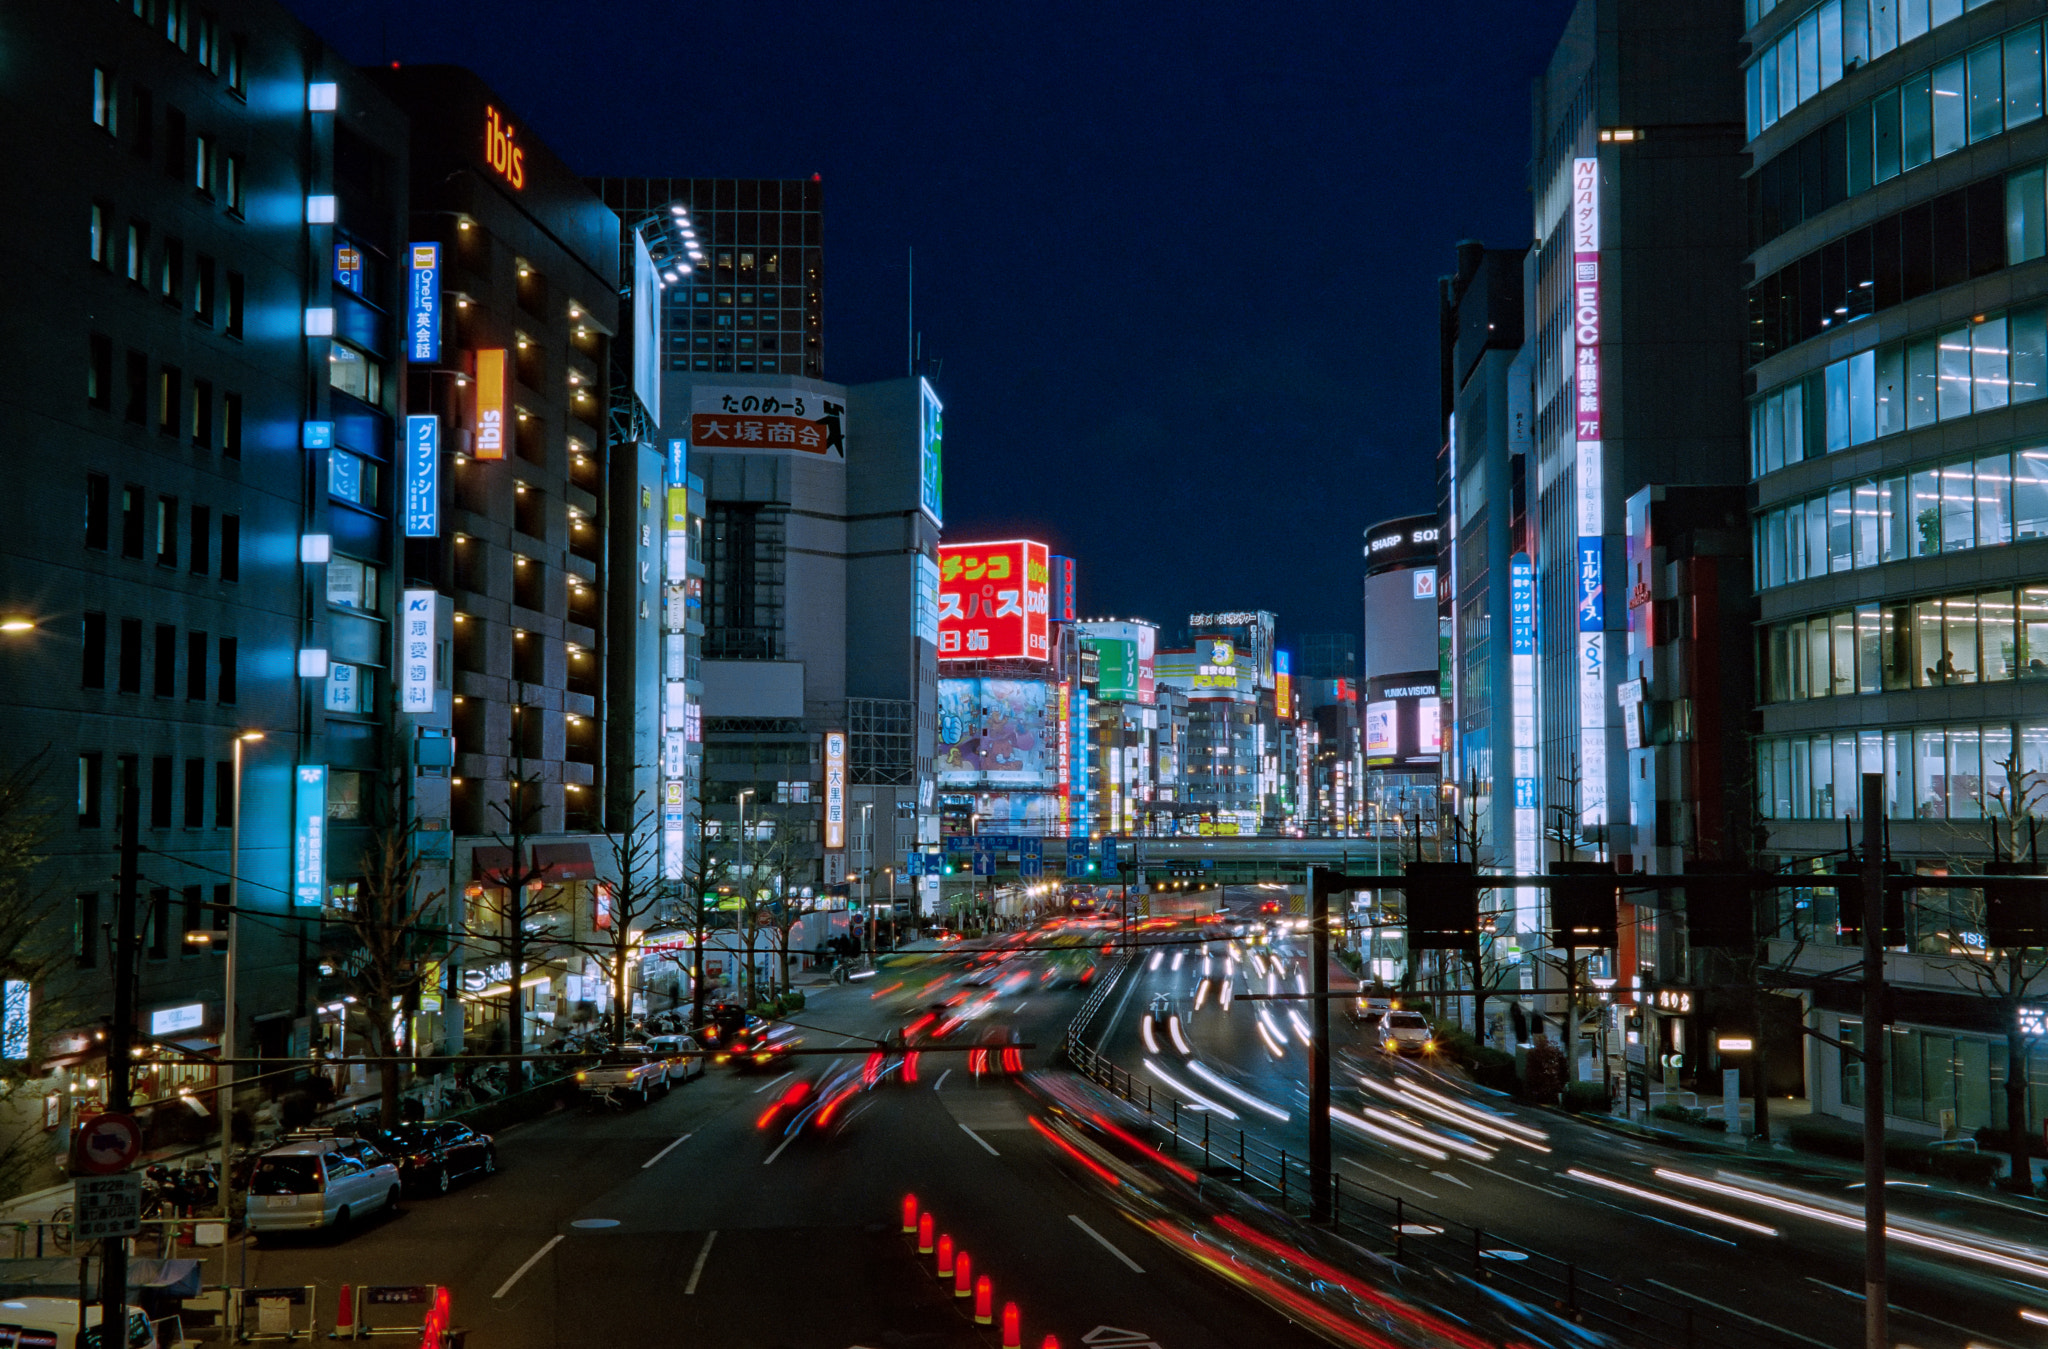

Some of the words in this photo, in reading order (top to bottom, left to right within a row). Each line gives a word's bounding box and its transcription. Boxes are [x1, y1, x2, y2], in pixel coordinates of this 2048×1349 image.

[486, 104, 524, 190] ibis
[722, 394, 805, 416] たのめーる
[478, 410, 501, 450] ibis
[700, 421, 821, 447] 大塚商会
[1580, 421, 1598, 436] 7F
[418, 423, 433, 531] グランシーズ
[1371, 535, 1402, 551] SHARP
[938, 555, 1010, 582] チンコ
[1384, 687, 1408, 698] YUNIKA
[1408, 685, 1436, 695] VISION
[829, 768, 842, 823] 大黒屋
